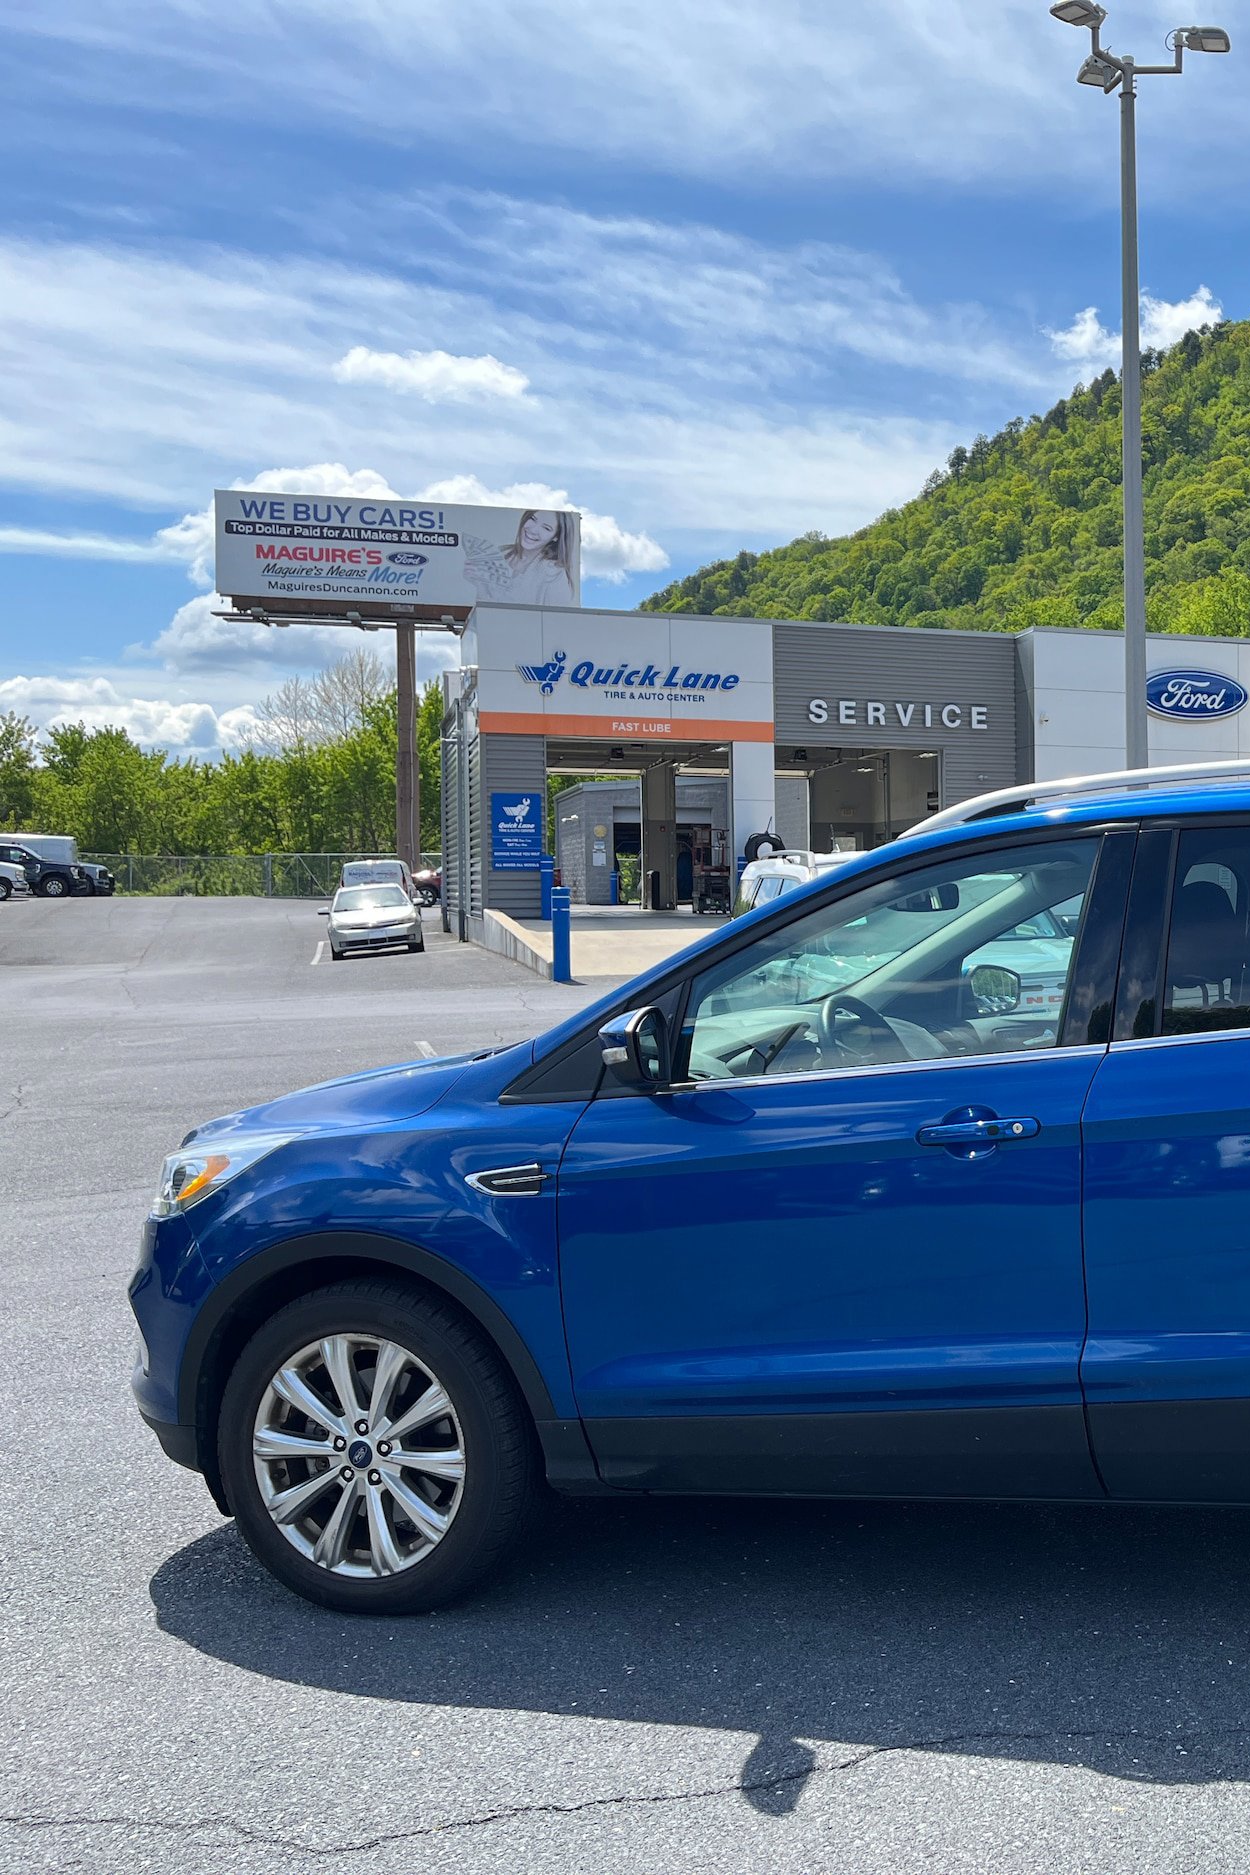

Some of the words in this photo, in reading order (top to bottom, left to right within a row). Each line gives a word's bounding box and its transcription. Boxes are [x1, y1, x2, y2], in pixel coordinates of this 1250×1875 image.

[240, 499, 285, 520] WE
[293, 503, 352, 523] BUY
[359, 506, 444, 529] CARS!
[230, 522, 253, 534] Top
[255, 523, 291, 536] Dollar
[294, 525, 320, 537] Paid
[323, 528, 340, 538] for
[342, 528, 358, 539] All
[361, 529, 399, 542] Makes
[400, 532, 410, 542] &
[412, 532, 455, 545] Models
[256, 544, 382, 565] MAGUIRE'S
[394, 554, 421, 565] Ford
[262, 563, 323, 578] Maguire's
[326, 565, 368, 578] Means
[367, 566, 424, 584] More!
[268, 581, 418, 596] MaguiresDuncannon.com
[570, 661, 660, 687] Quick
[662, 666, 740, 690] Lane
[604, 691, 626, 699] TIRE
[637, 692, 664, 701] AUTO
[668, 693, 705, 702] CENTER
[1160, 678, 1227, 710] Ford
[808, 699, 988, 730] SERVICE
[612, 721, 639, 732] FAST
[642, 723, 671, 733] LUBE
